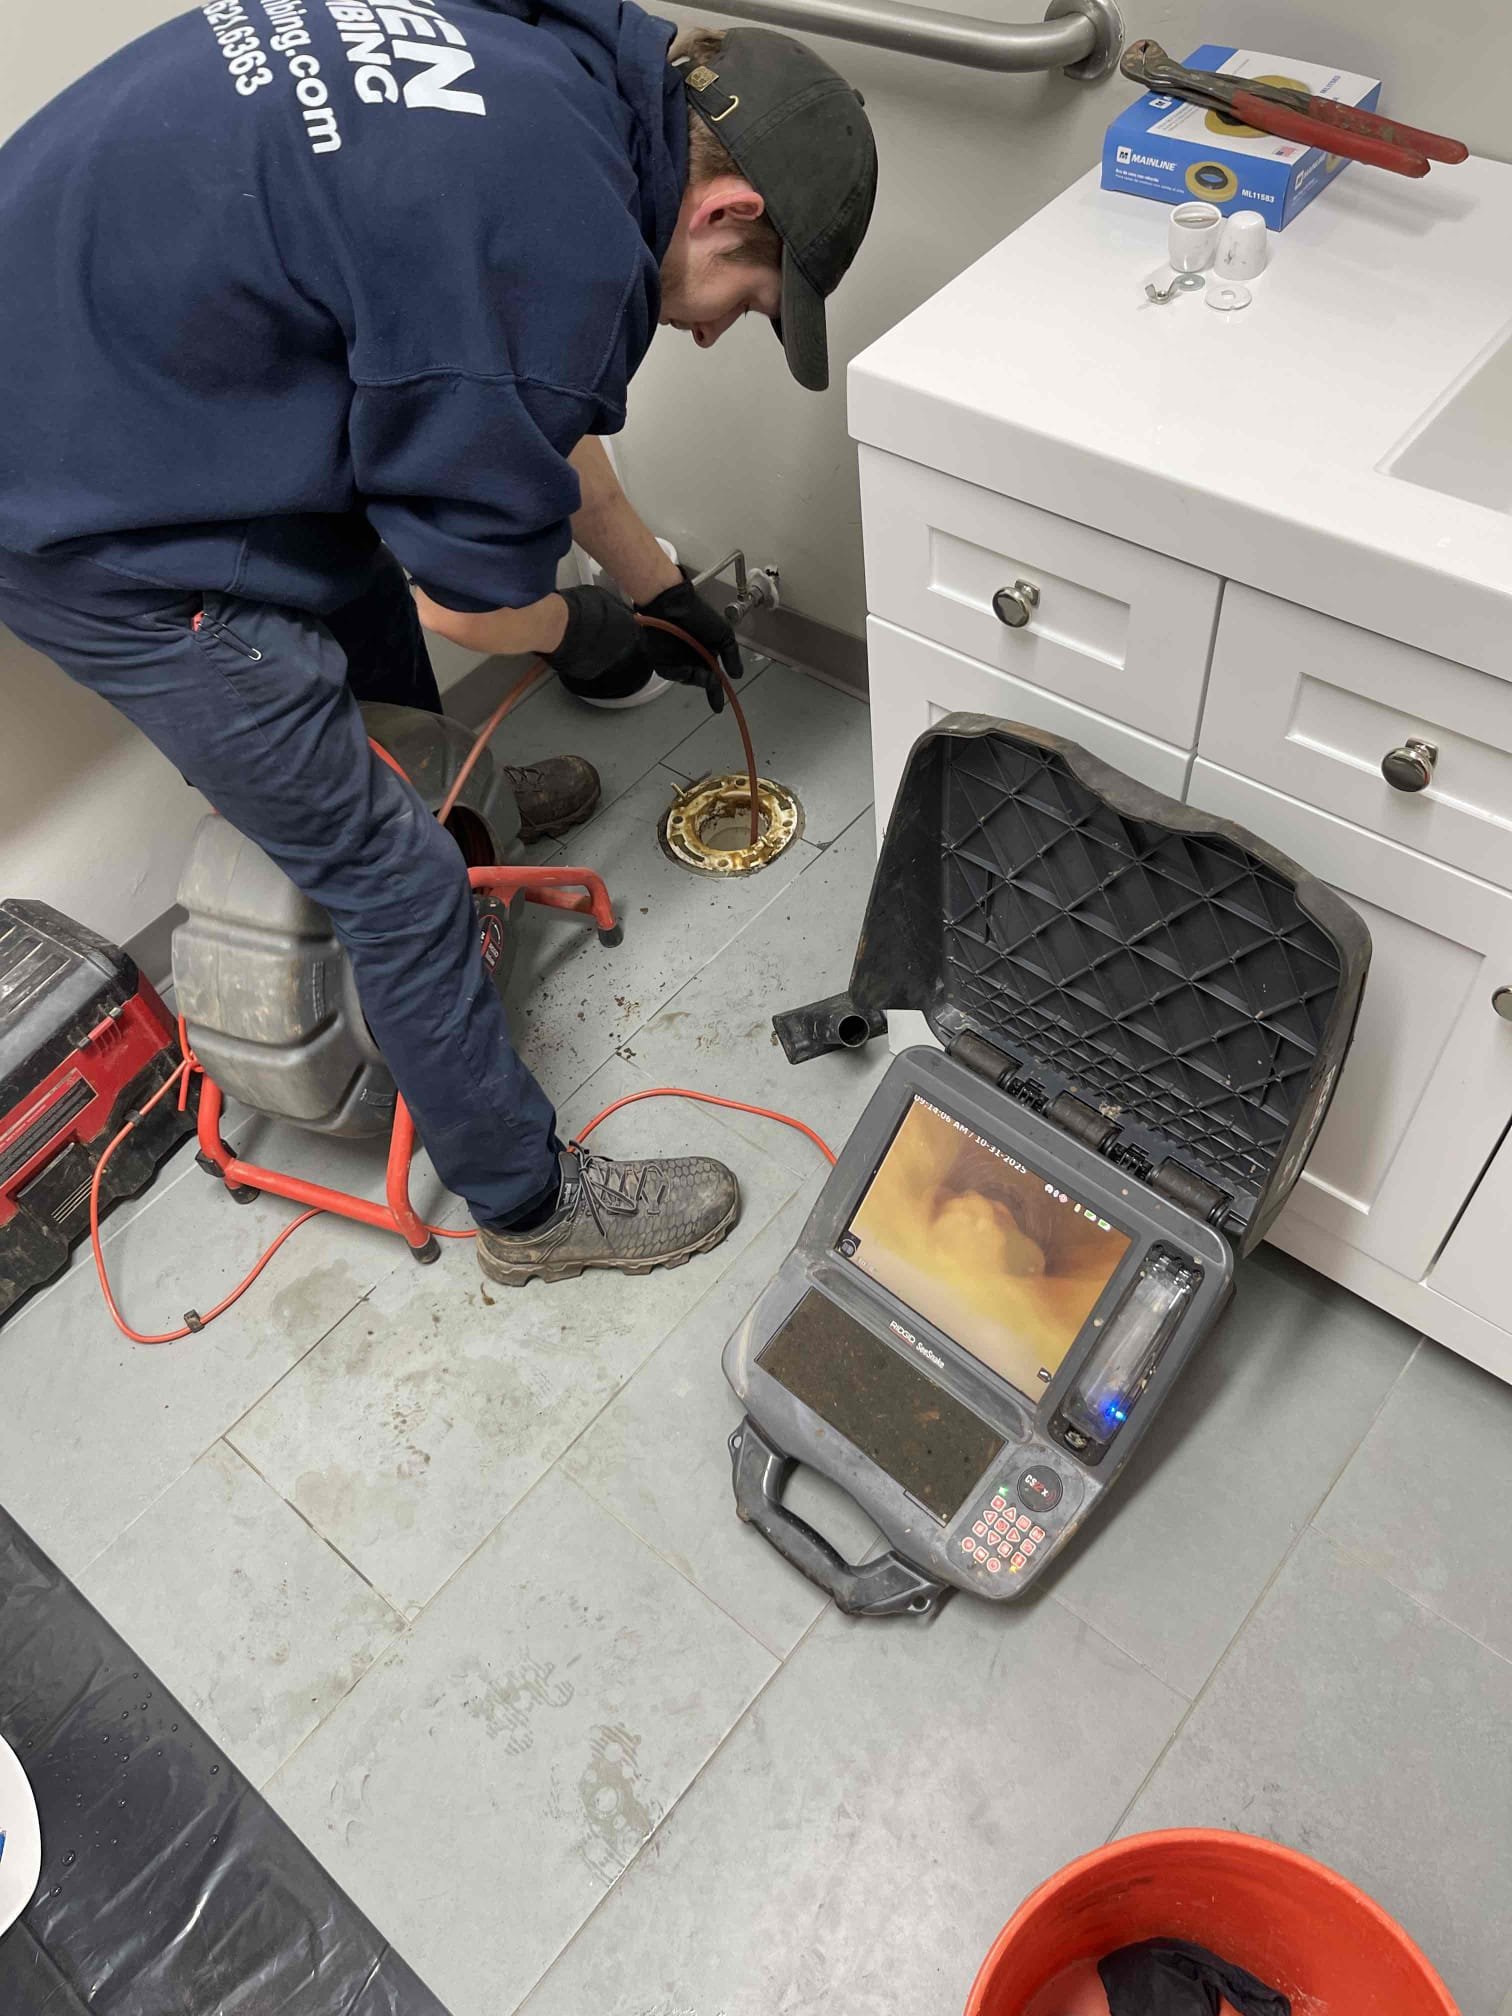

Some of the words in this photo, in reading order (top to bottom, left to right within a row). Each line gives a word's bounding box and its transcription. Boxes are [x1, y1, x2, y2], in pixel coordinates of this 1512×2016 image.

[1131, 153, 1176, 172] MAINLINE
[1241, 188, 1275, 204] ML11583
[953, 1120, 969, 1136] AM
[975, 1135, 1028, 1175] 10-31-2025
[889, 1320, 916, 1344] RIDGID
[916, 1341, 945, 1369] SeeSnake
